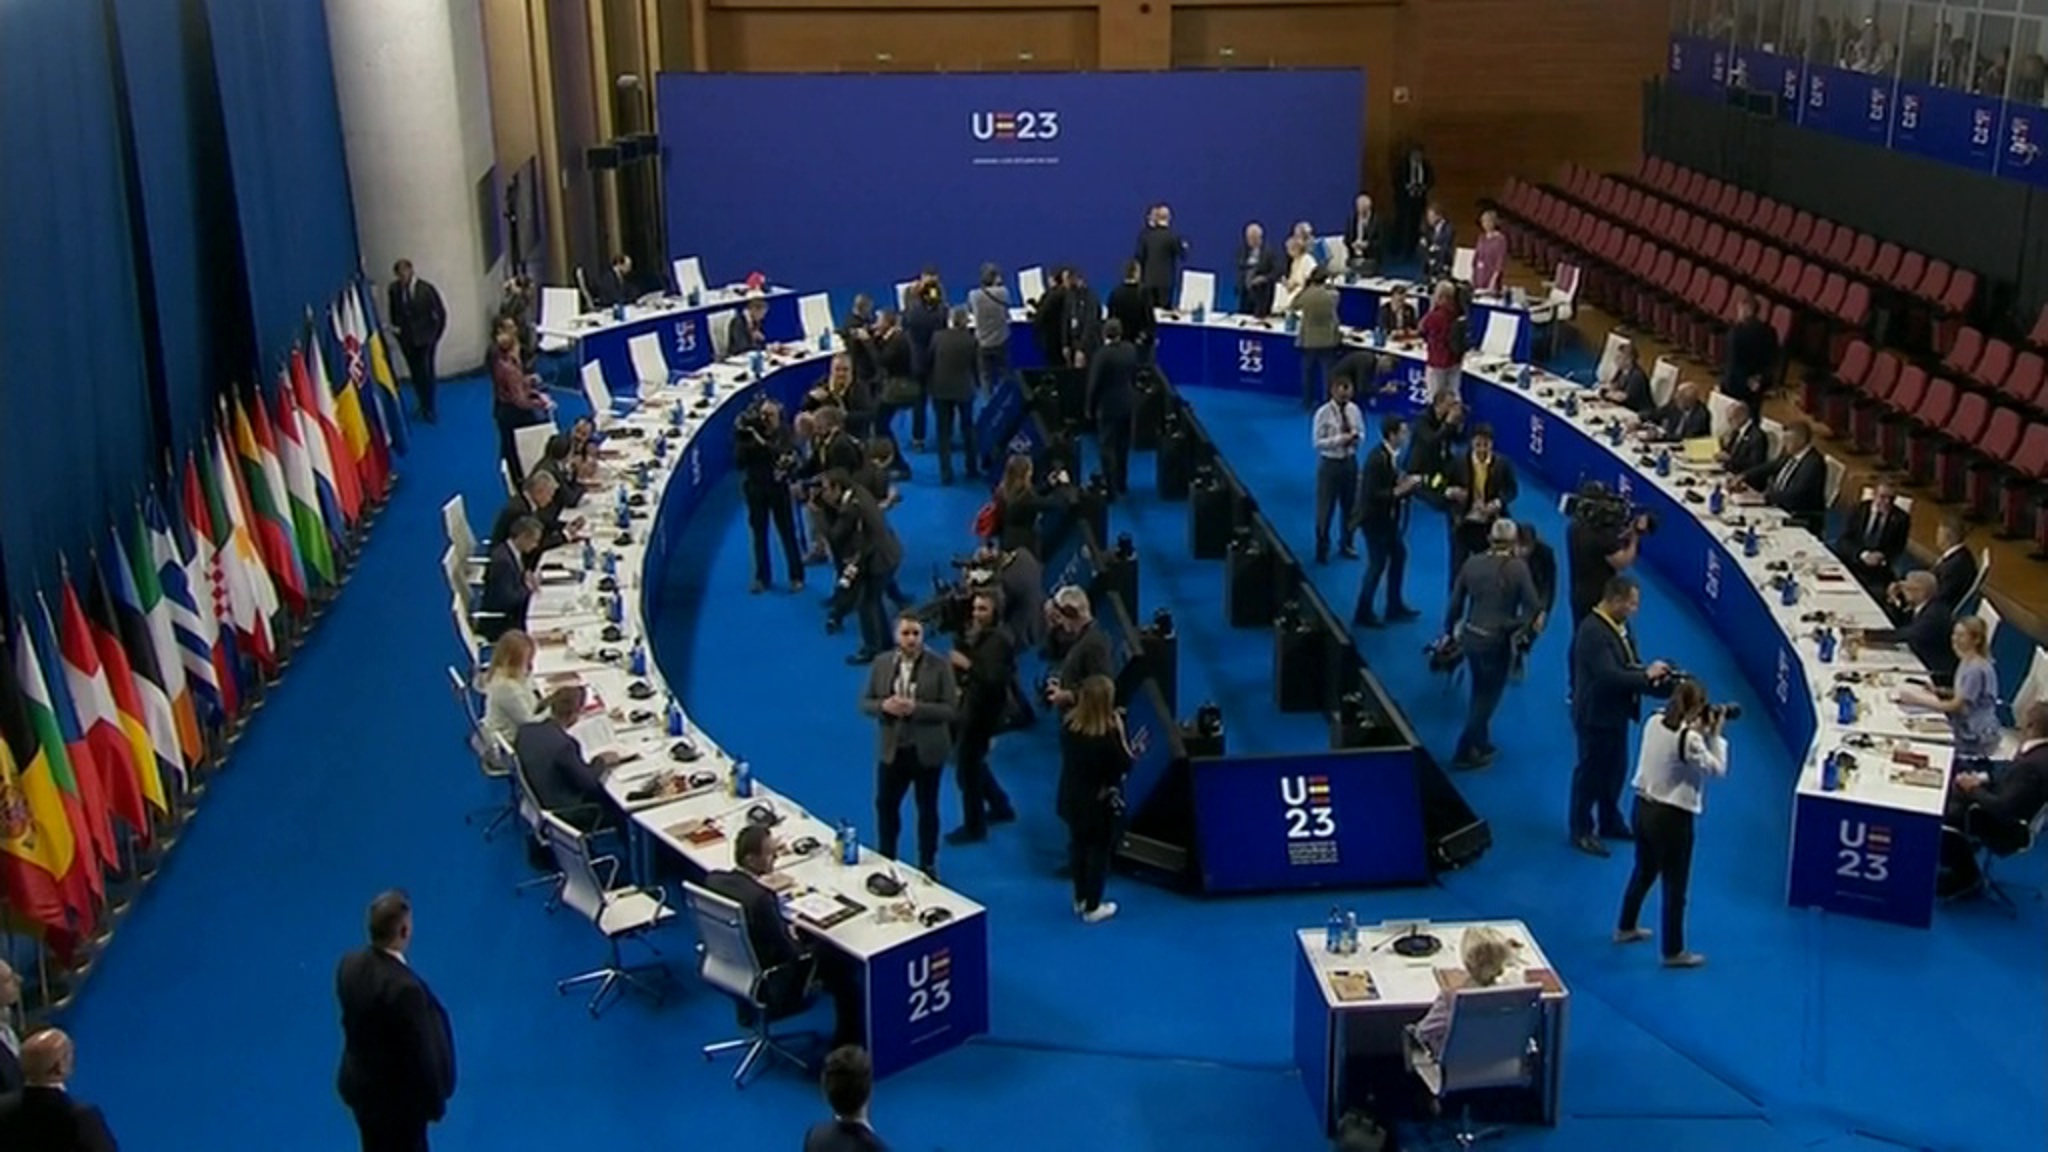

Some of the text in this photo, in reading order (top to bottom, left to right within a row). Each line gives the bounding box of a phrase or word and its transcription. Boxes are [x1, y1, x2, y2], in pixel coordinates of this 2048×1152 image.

[972, 111, 1059, 140] UE23
[1239, 355, 1263, 373] 23
[1280, 775, 1332, 806] UE
[1284, 807, 1336, 838] 23
[1839, 819, 1892, 853] UE
[1836, 849, 1889, 881] 23
[907, 947, 951, 989] UE
[908, 979, 952, 1023] 23
